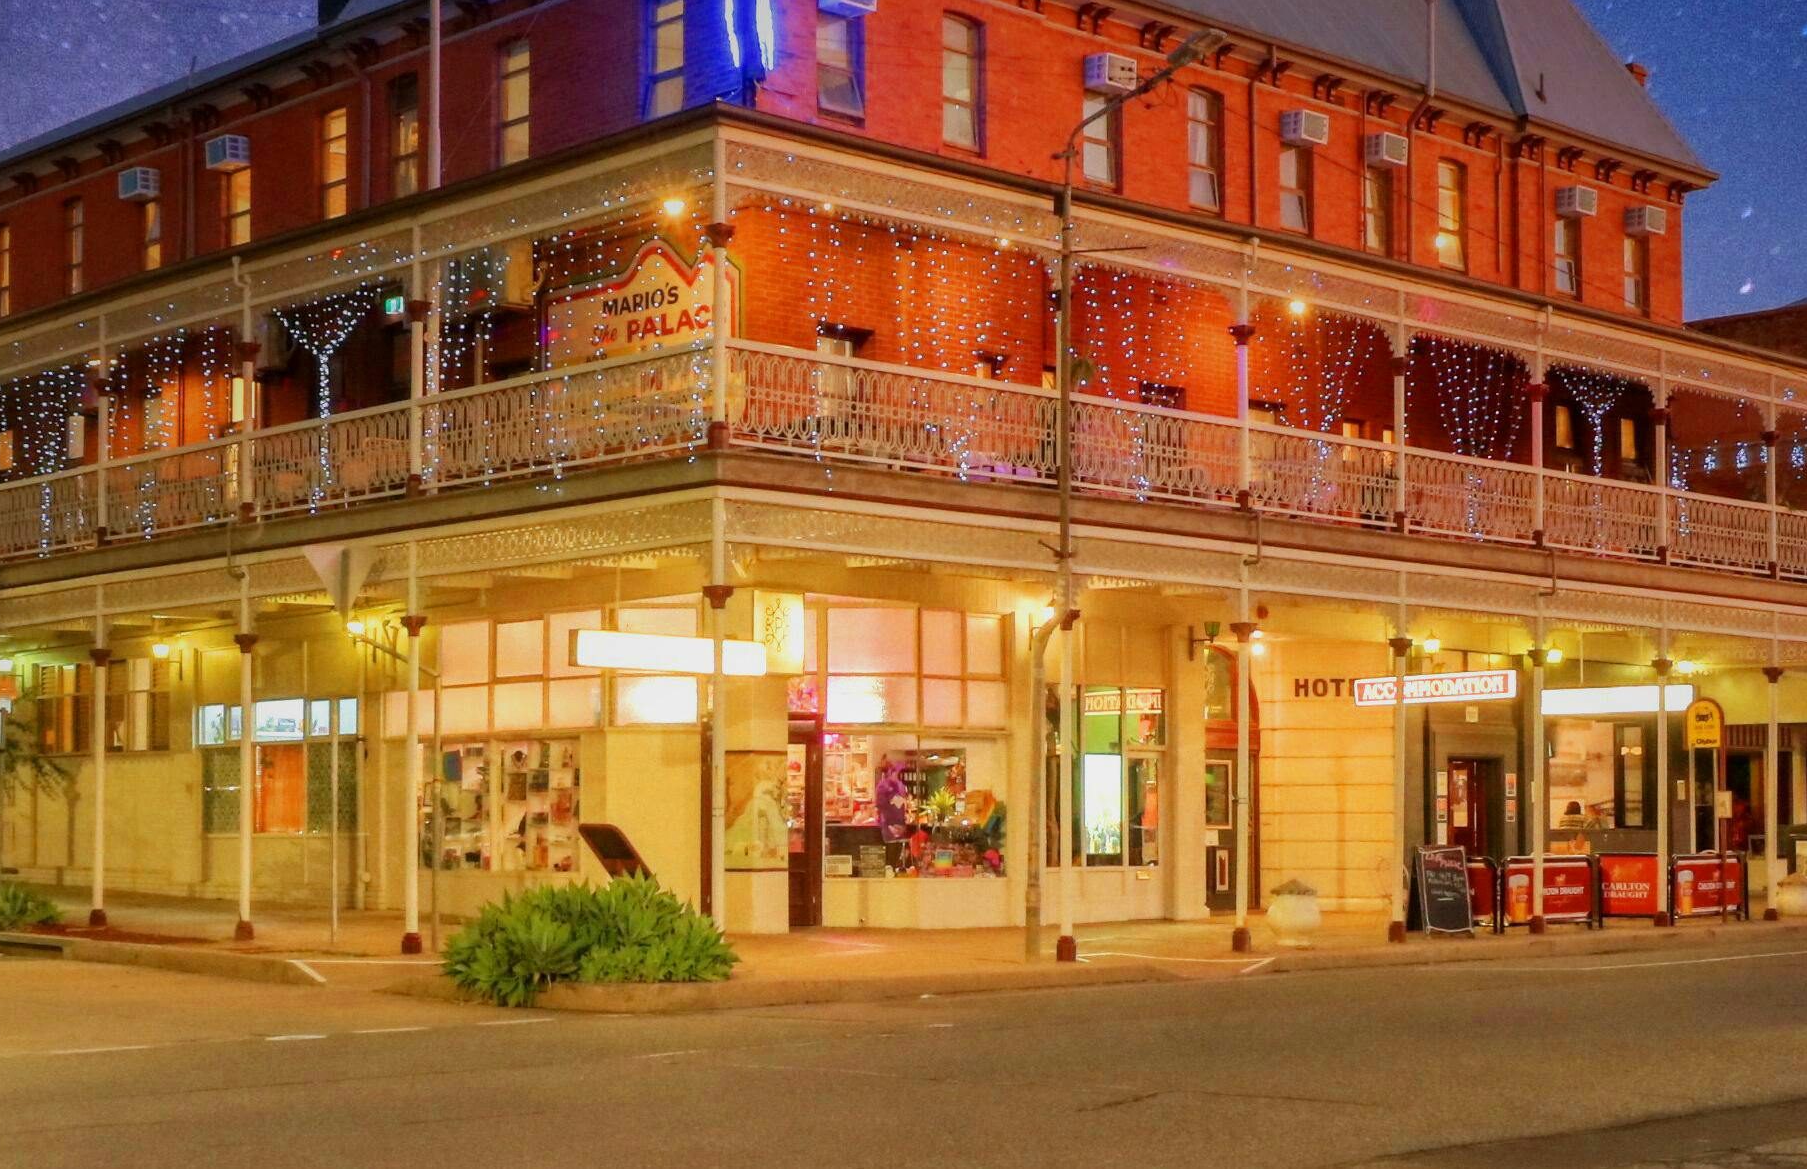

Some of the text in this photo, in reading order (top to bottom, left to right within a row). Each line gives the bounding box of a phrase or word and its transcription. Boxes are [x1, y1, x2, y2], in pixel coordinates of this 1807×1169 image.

[602, 283, 680, 317] MARIO'S
[626, 304, 712, 343] PALAC
[1361, 675, 1505, 701] ACCMMODATION
[1601, 882, 1650, 891] CARLTON
[1603, 891, 1648, 899] DRAUGHT
